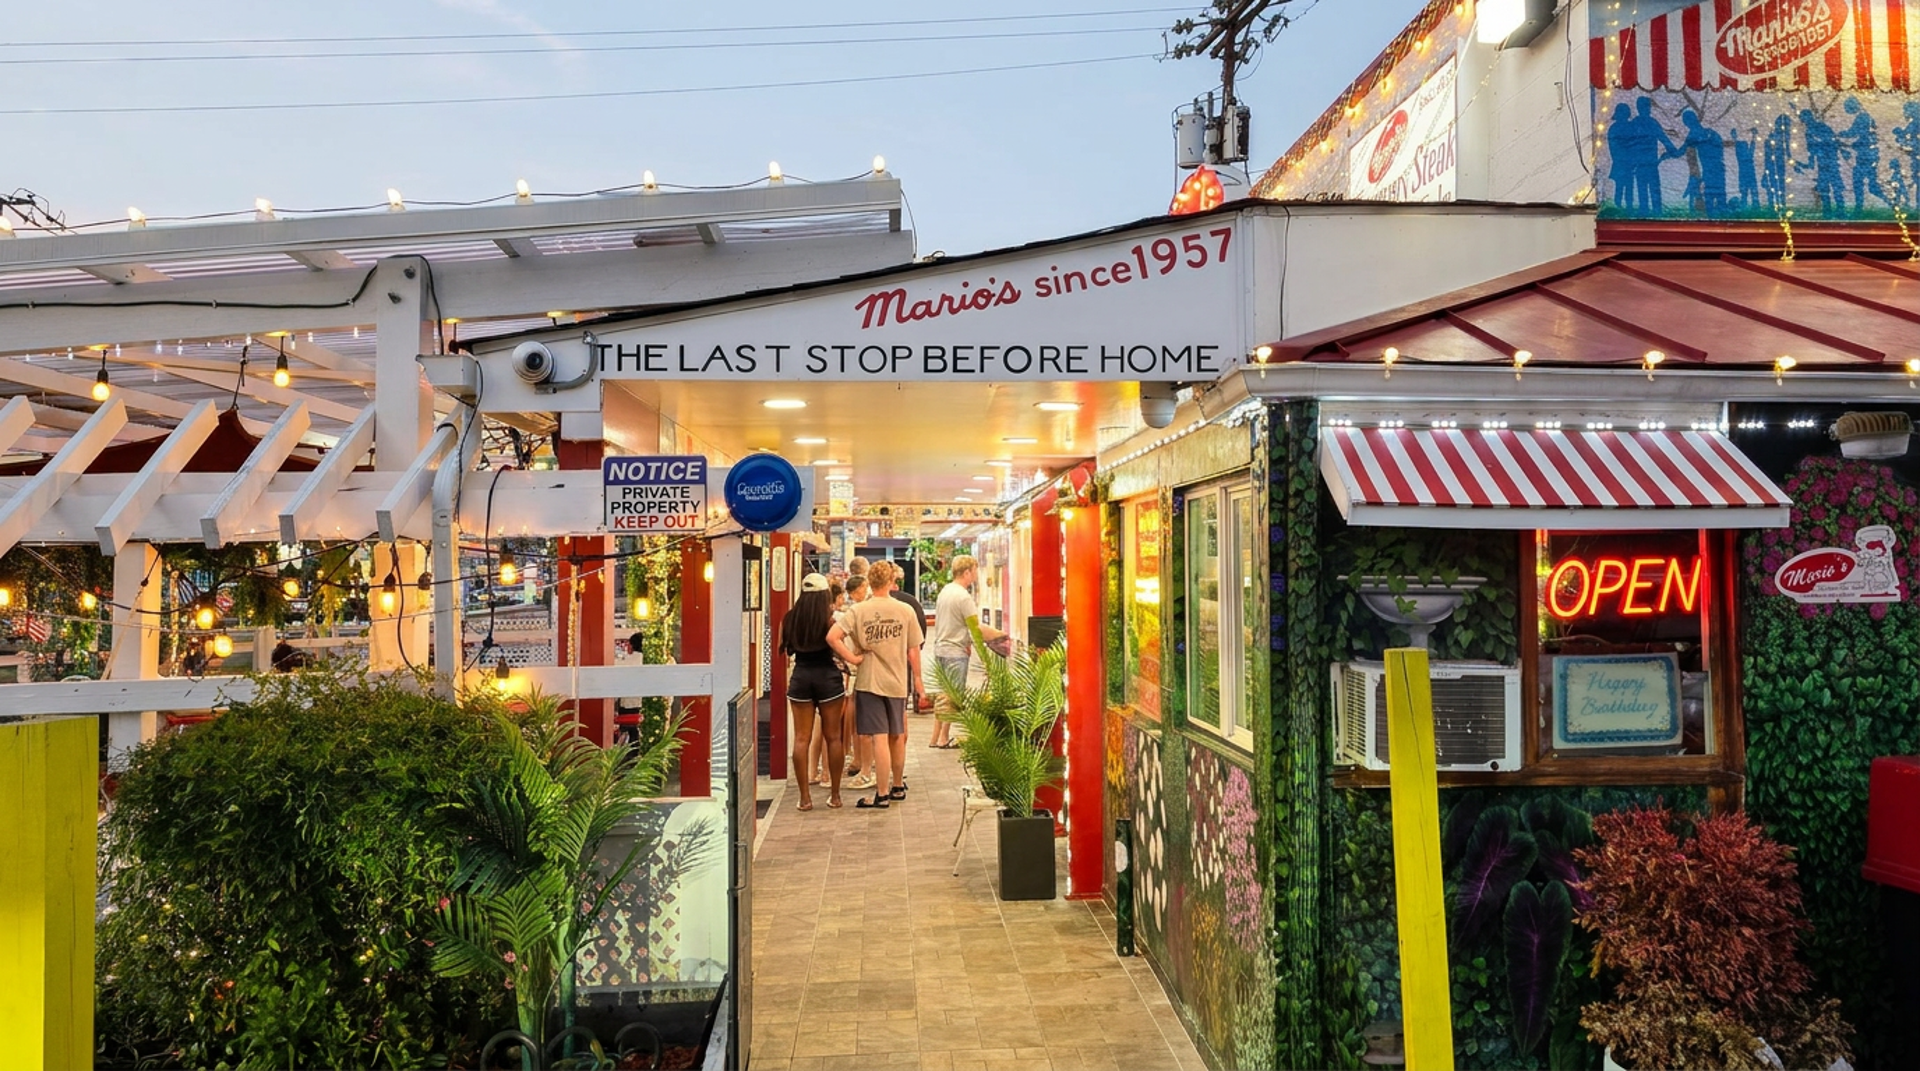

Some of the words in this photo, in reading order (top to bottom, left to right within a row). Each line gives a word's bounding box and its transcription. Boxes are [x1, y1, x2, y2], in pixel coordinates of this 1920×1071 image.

[855, 277, 1021, 329] Mario's
[596, 344, 668, 372] THE
[679, 344, 791, 373] LAST
[805, 345, 913, 373] STOP
[923, 345, 1089, 373] BEFORE
[1100, 345, 1219, 373] HOME
[608, 461, 703, 482] NOTICE
[622, 486, 691, 499] PRIVATE
[610, 500, 701, 514] PROPERTY
[614, 516, 659, 529] KEEP
[664, 515, 699, 528] OUT
[1549, 556, 1702, 618] OPEN
